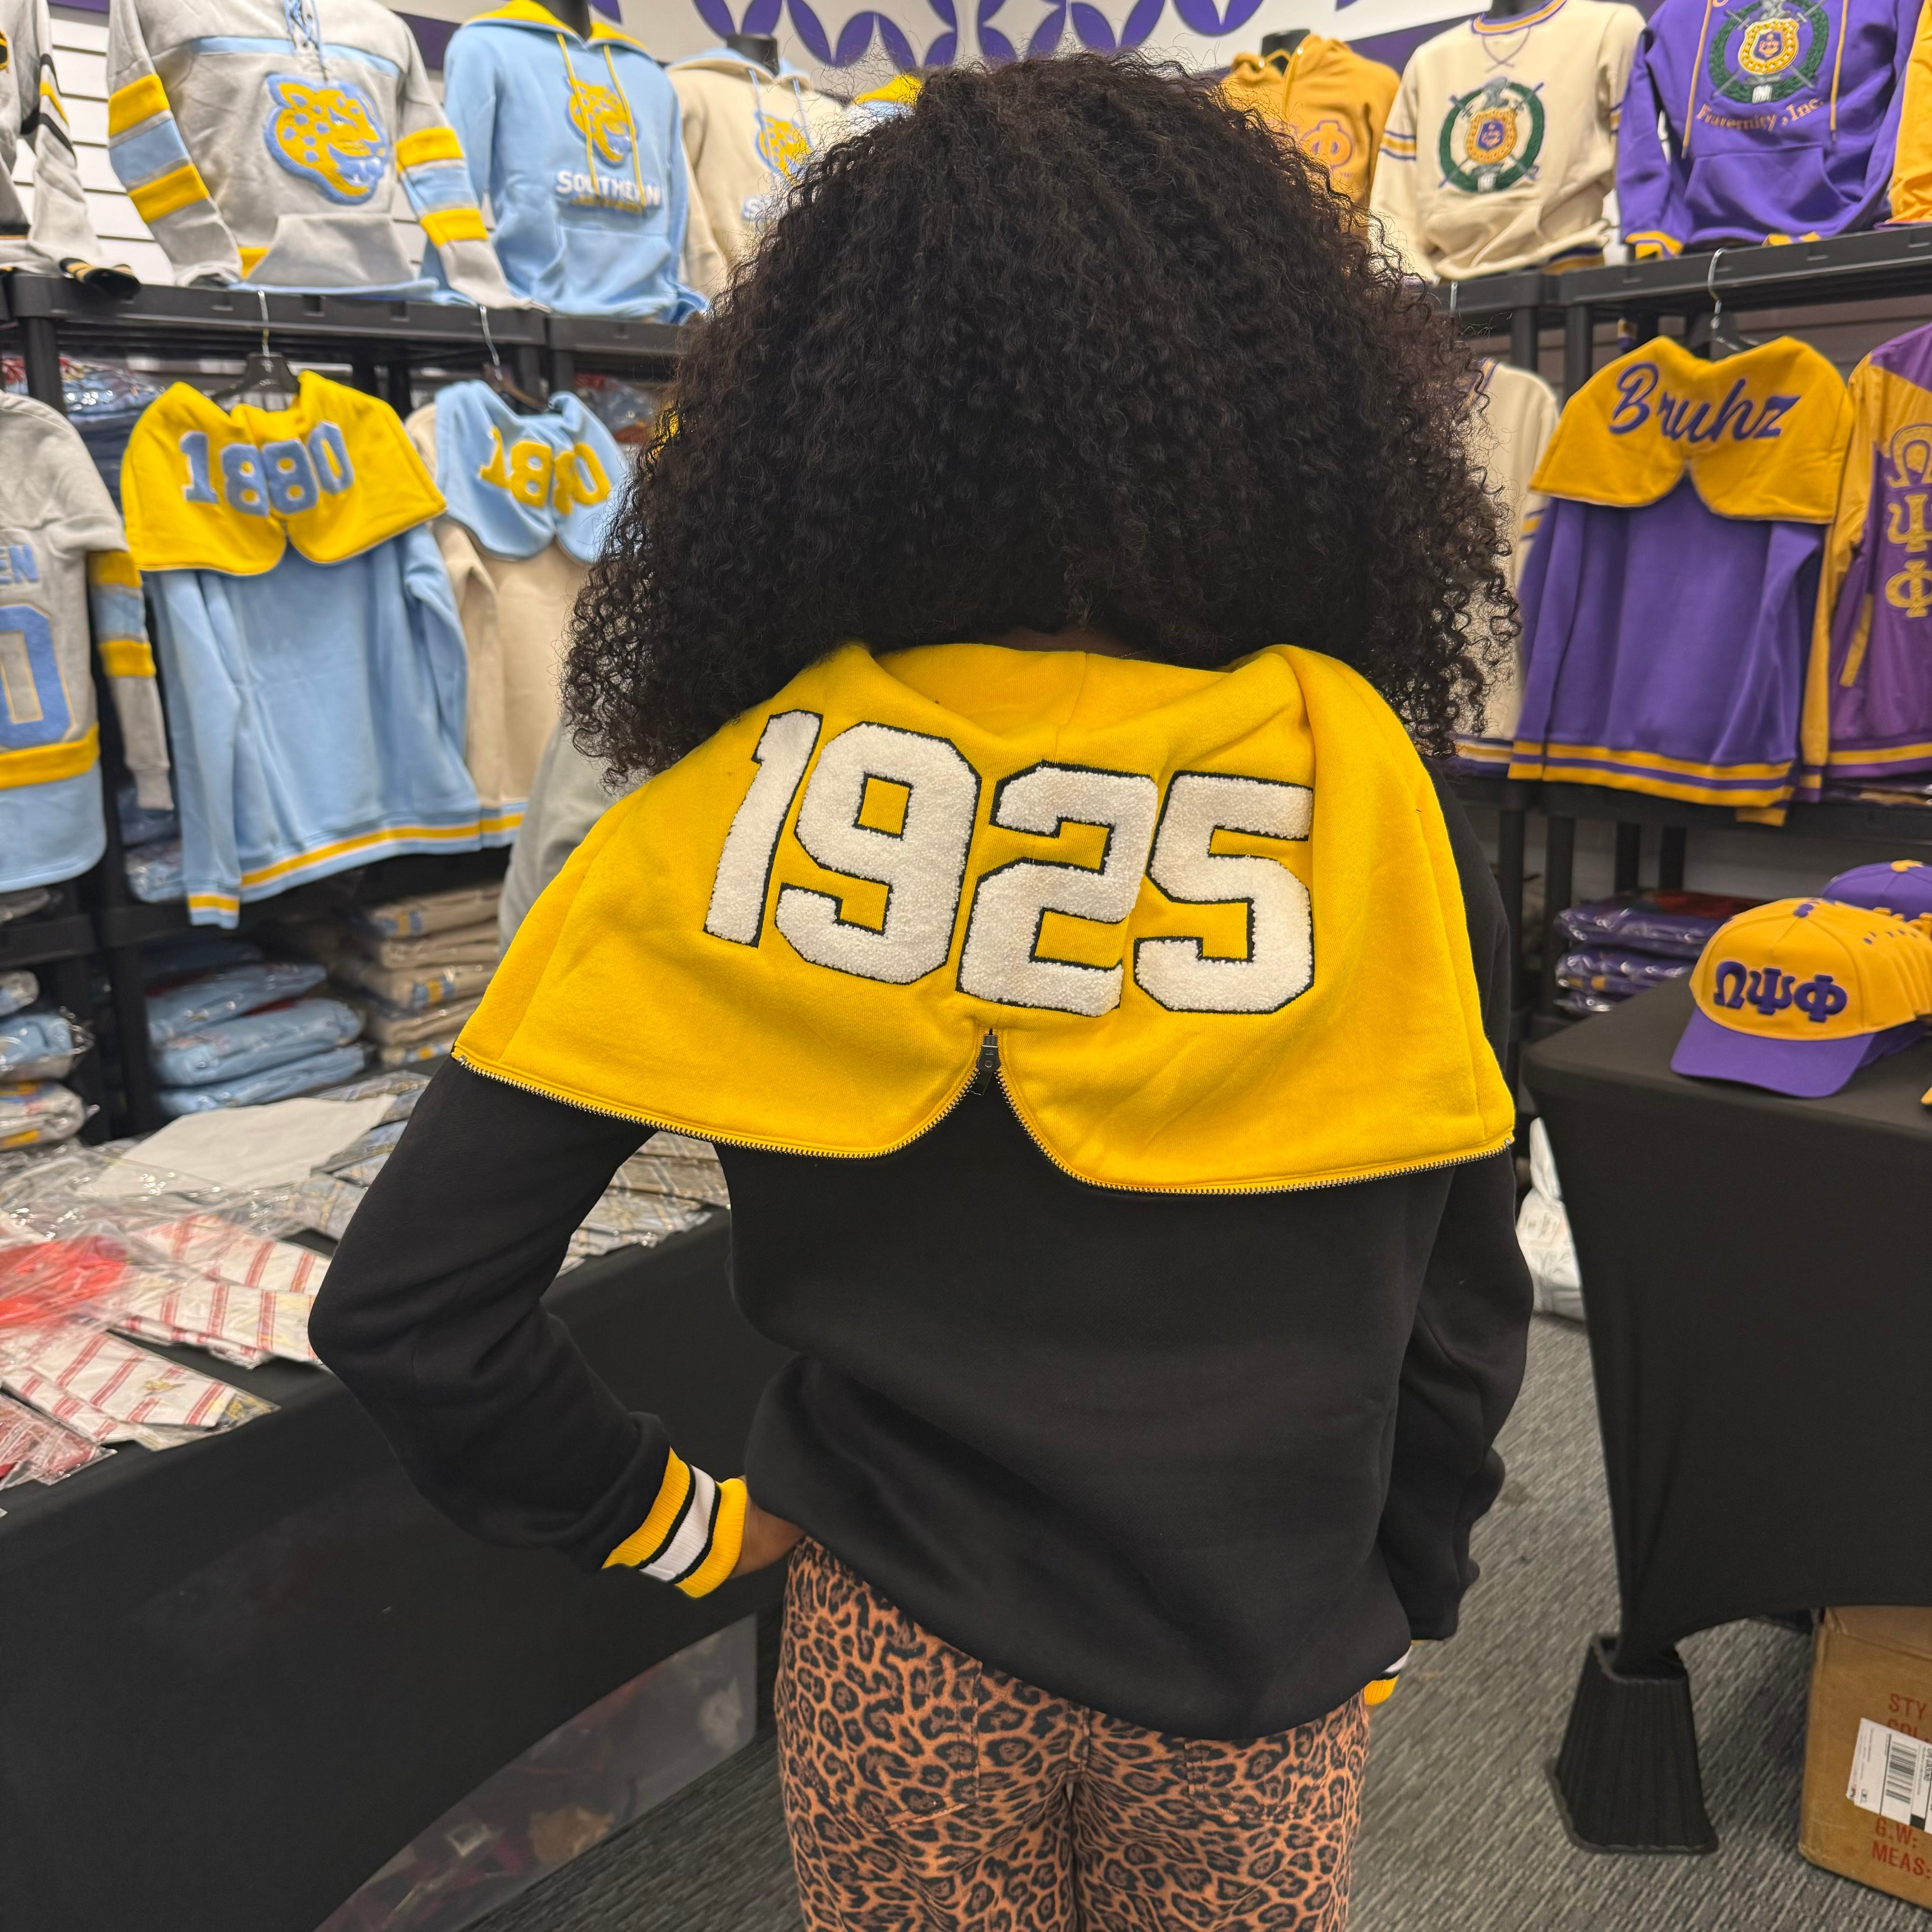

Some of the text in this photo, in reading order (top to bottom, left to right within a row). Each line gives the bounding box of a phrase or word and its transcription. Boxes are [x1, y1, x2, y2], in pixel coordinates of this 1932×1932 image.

[1609, 362, 1801, 443] Bruhz
[179, 420, 355, 517] 1880
[704, 709, 1315, 1017] 1925
[1713, 960, 1848, 1023] ΩΨΦ
[1872, 1840, 1932, 1880] MEAS:
